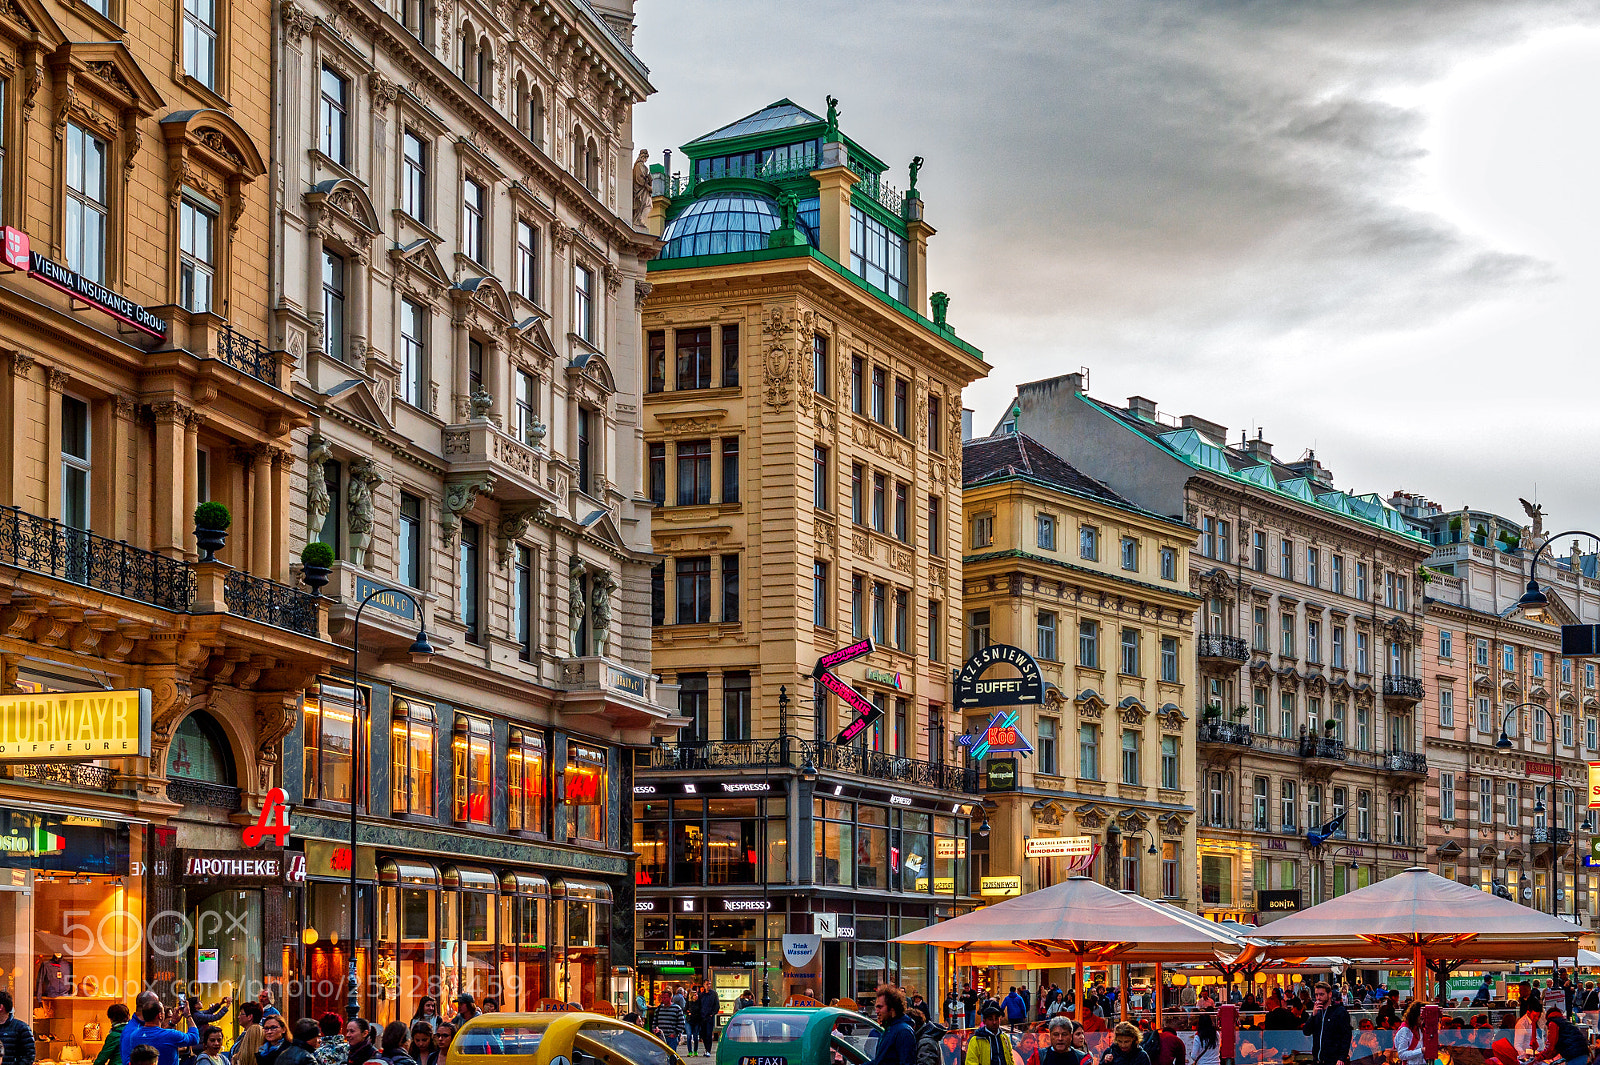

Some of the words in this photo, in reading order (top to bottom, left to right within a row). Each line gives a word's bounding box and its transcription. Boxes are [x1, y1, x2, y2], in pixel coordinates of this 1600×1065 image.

[77, 273, 133, 317] INSURANCE
[135, 304, 167, 333] GROUP
[821, 641, 869, 664] DISCOTHEQUE
[975, 681, 1022, 693] BUFFET
[820, 674, 871, 716] FLEDERMAUS
[721, 783, 770, 793] NESPRESSO
[191, 858, 277, 876] APOTHEKE
[546, 1003, 569, 1012] FAXI
[758, 1057, 783, 1065] FAXI
